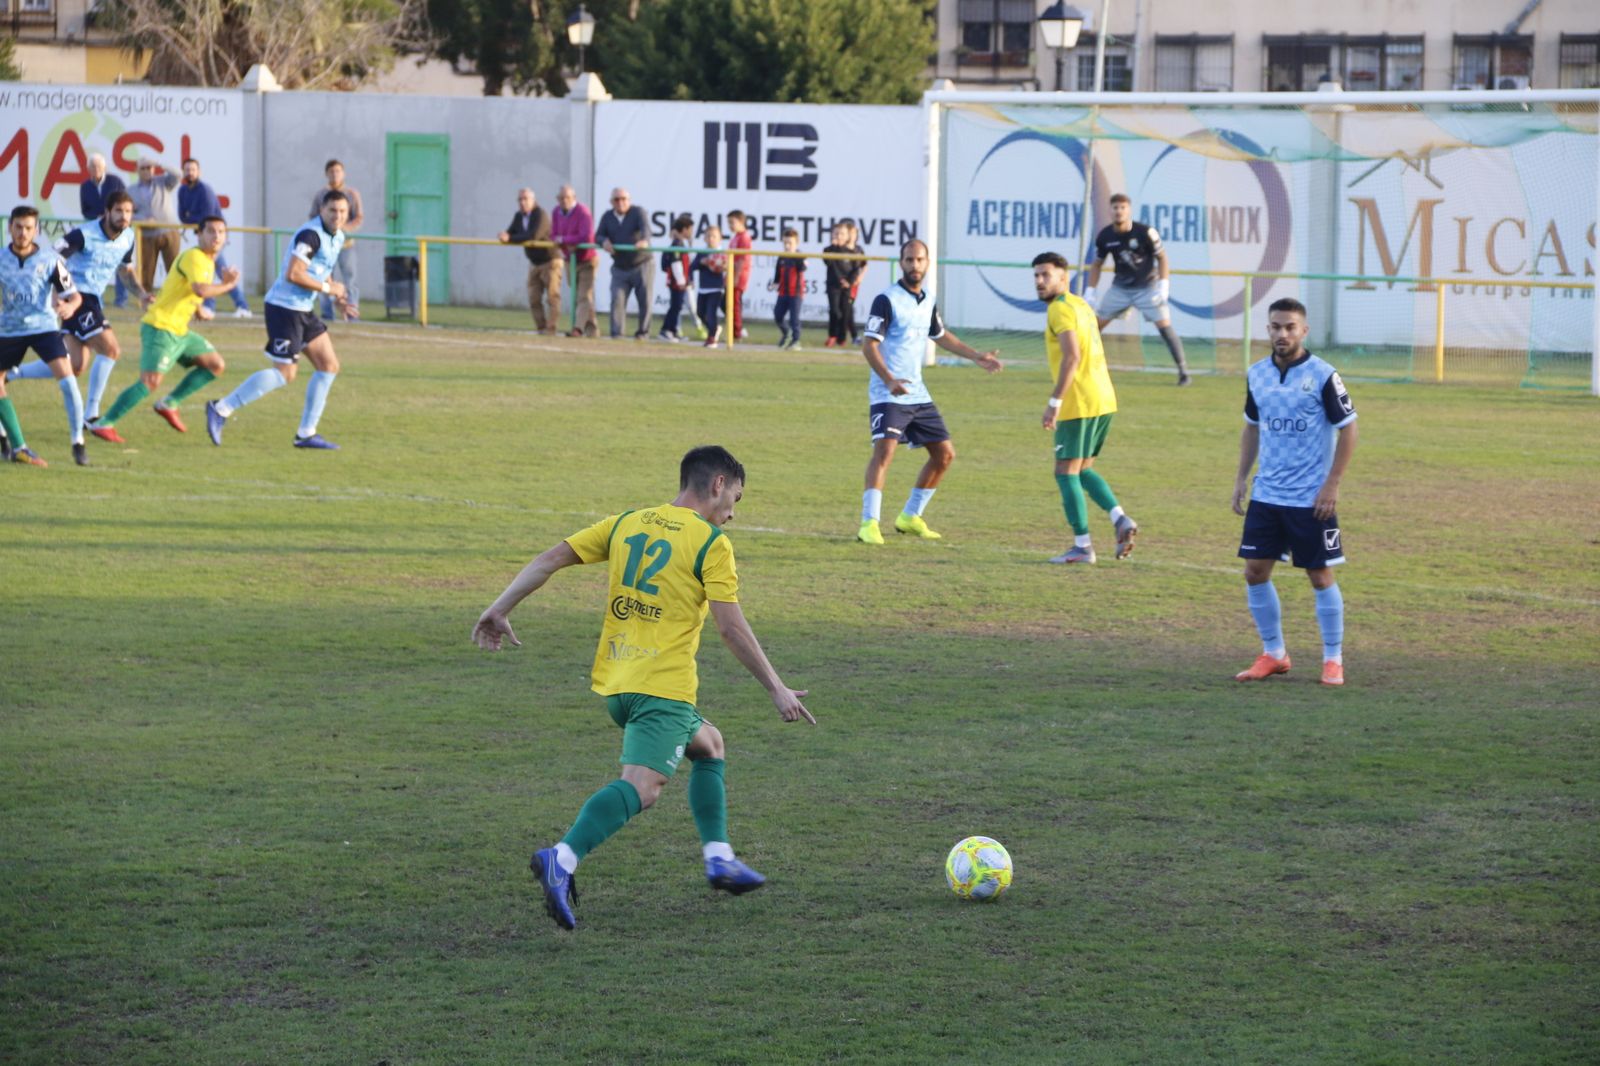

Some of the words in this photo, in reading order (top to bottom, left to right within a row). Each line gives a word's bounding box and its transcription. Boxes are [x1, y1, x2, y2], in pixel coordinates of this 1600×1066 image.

[745, 215, 916, 246] BEETHVEN
[1266, 415, 1308, 433] tono
[621, 531, 672, 595] 12
